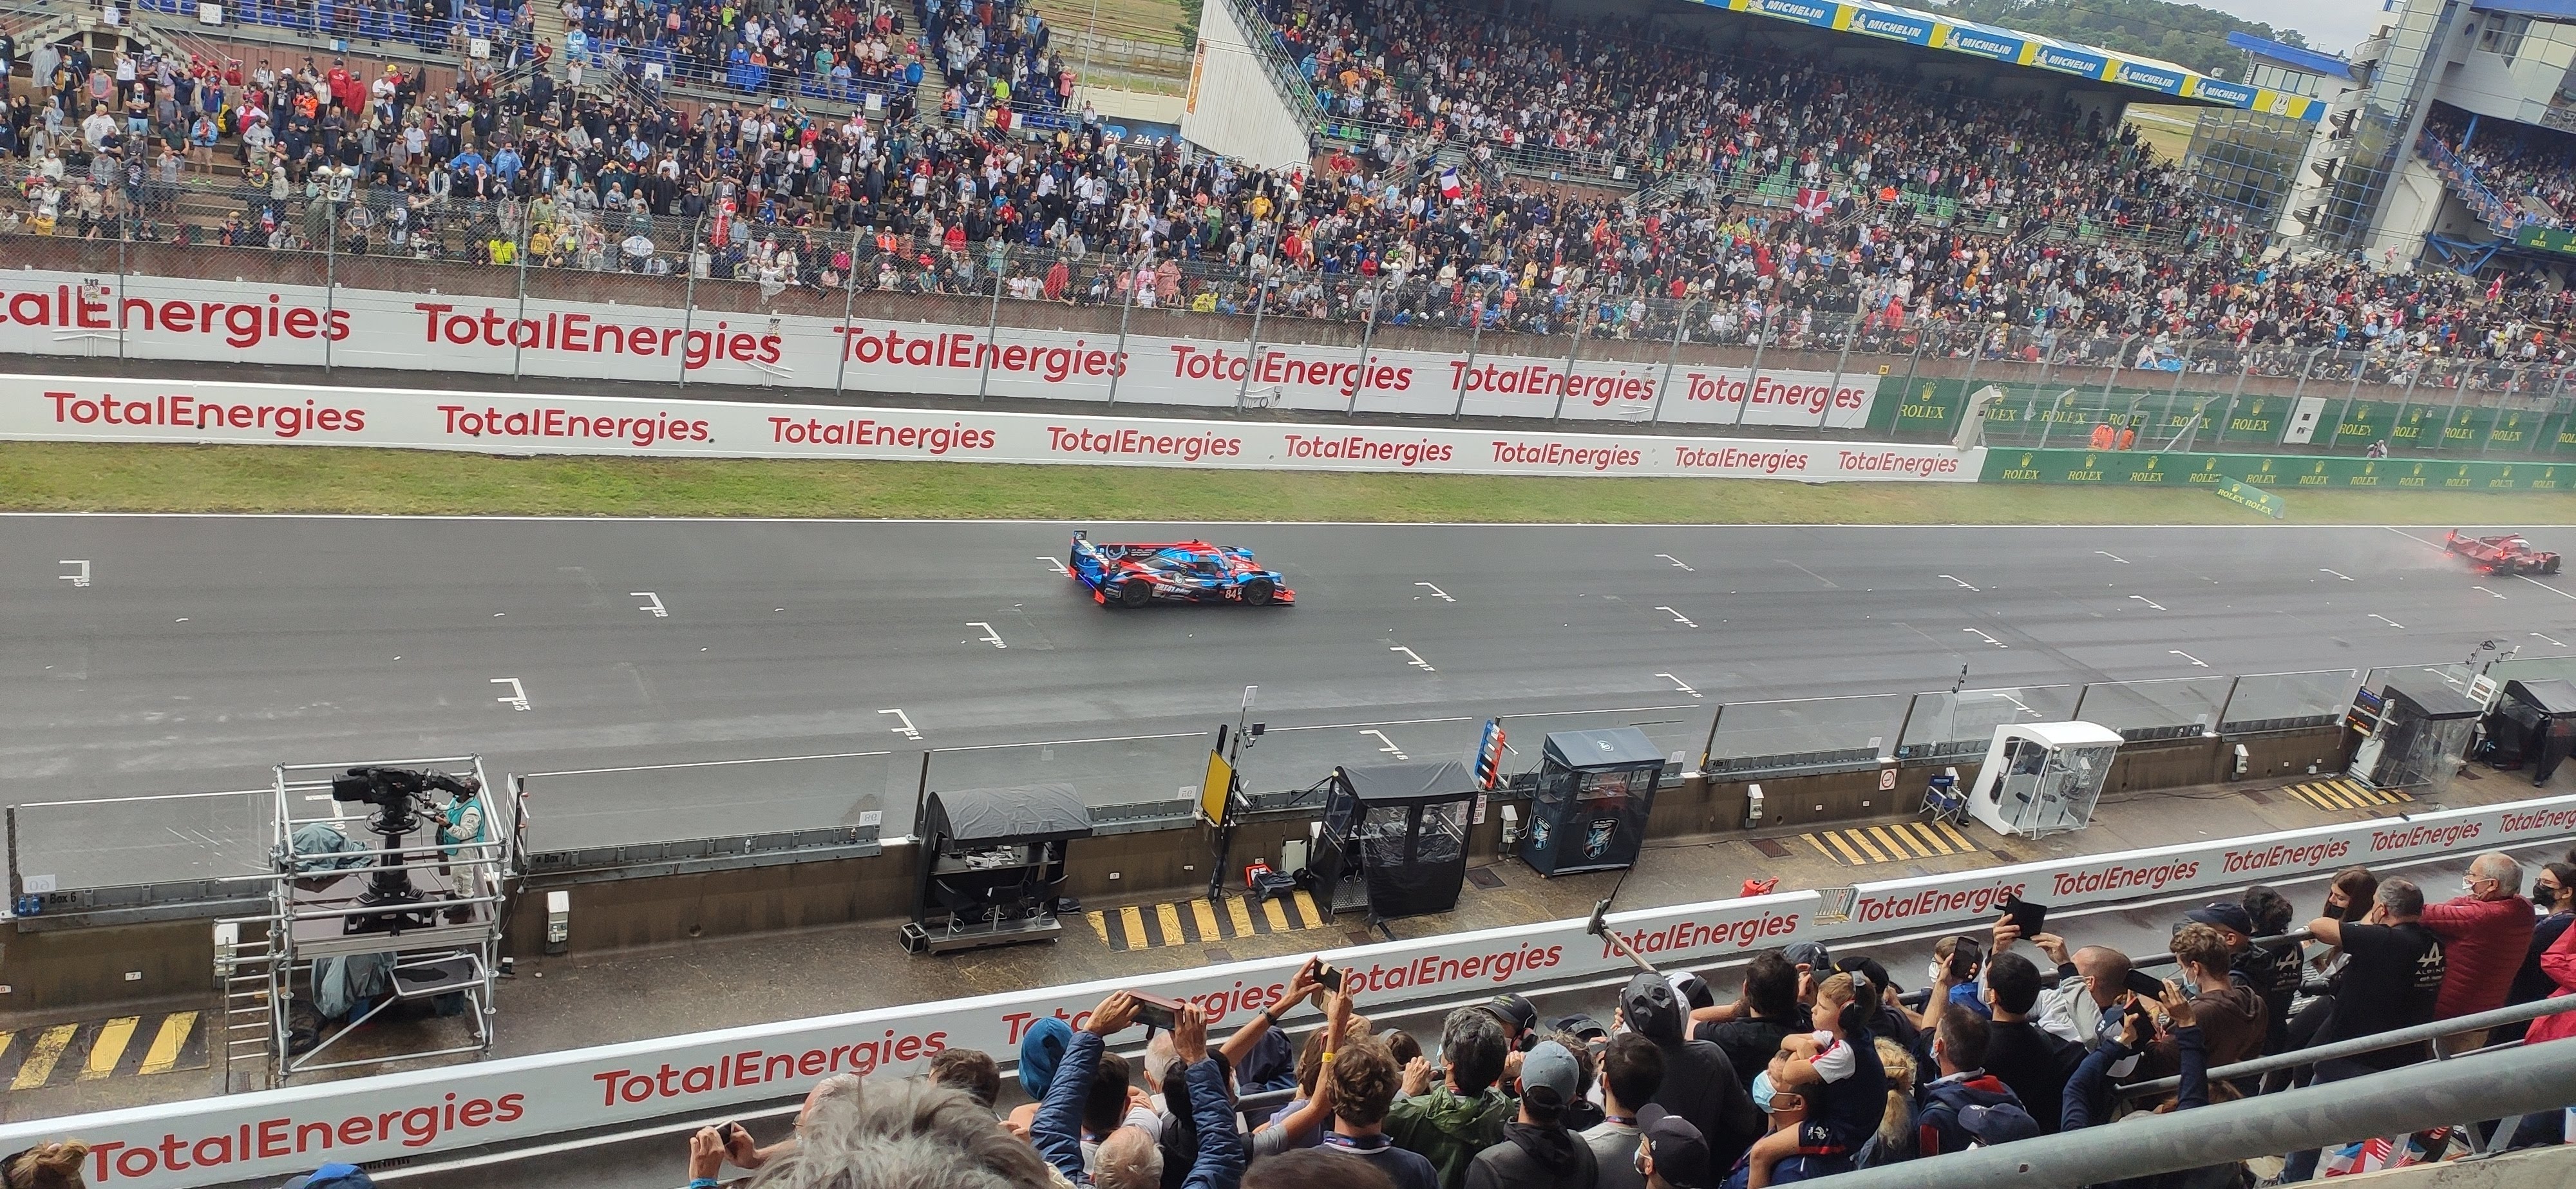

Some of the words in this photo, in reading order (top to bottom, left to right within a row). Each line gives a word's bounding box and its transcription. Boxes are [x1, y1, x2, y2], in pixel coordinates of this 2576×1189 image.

[1765, 0, 1825, 19] MICHELIN
[1867, 19, 1922, 37] MICHELIN
[1960, 37, 2012, 55] MICHELIN
[2048, 54, 2097, 72] MICHELIN
[2129, 71, 2176, 88] MICHELIN
[2205, 87, 2248, 102] MICHELIN
[0, 284, 350, 348] alEnergies
[415, 303, 781, 370] TotalEnergies
[833, 326, 1128, 383] TotalEnergies
[1171, 345, 1412, 397] TotalEnergies
[1450, 360, 1655, 406] TotalEnergies
[1687, 373, 1864, 414] TotaEnerges
[44, 391, 365, 437] TotalEnergies
[1900, 405, 1944, 419] ROLEX
[437, 404, 709, 446] TotalEnergies
[2231, 418, 2269, 432] ROLEX
[768, 417, 996, 454] TotalEnergies
[1047, 426, 1241, 462] TotalEnergies
[2491, 430, 2522, 441] ROLEX
[1285, 434, 1452, 466] TotalEnergies
[1492, 441, 1640, 470] TotalEnergies
[1674, 446, 1808, 474] TotalEnergies
[1839, 450, 1958, 477] TotalEnergies
[2003, 470, 2040, 480] ROLEX
[2068, 471, 2103, 481] ROLEX
[2130, 472, 2164, 482] ROLEX
[2246, 473, 2277, 484] ROLEX
[2299, 475, 2329, 486] ROLEX
[2350, 476, 2379, 486] ROLEX
[2400, 477, 2426, 487] ROLEX
[2445, 478, 2471, 488] ROLEX
[2489, 479, 2514, 488] ROLEX
[2217, 488, 2244, 504] ROLEX
[2245, 499, 2273, 515] ROLEX
[1224, 589, 1236, 599] 84
[2370, 819, 2482, 851] TotalEnergies
[544, 854, 559, 863] Box
[561, 852, 566, 862] 7
[2222, 837, 2351, 873] TotalEnergies
[2052, 859, 2199, 897] TotalEnergies
[50, 893, 68, 904] Box
[70, 892, 77, 902] 6
[593, 1029, 948, 1107] TotalEnergies
[88, 1093, 525, 1181] TotalEnergies
